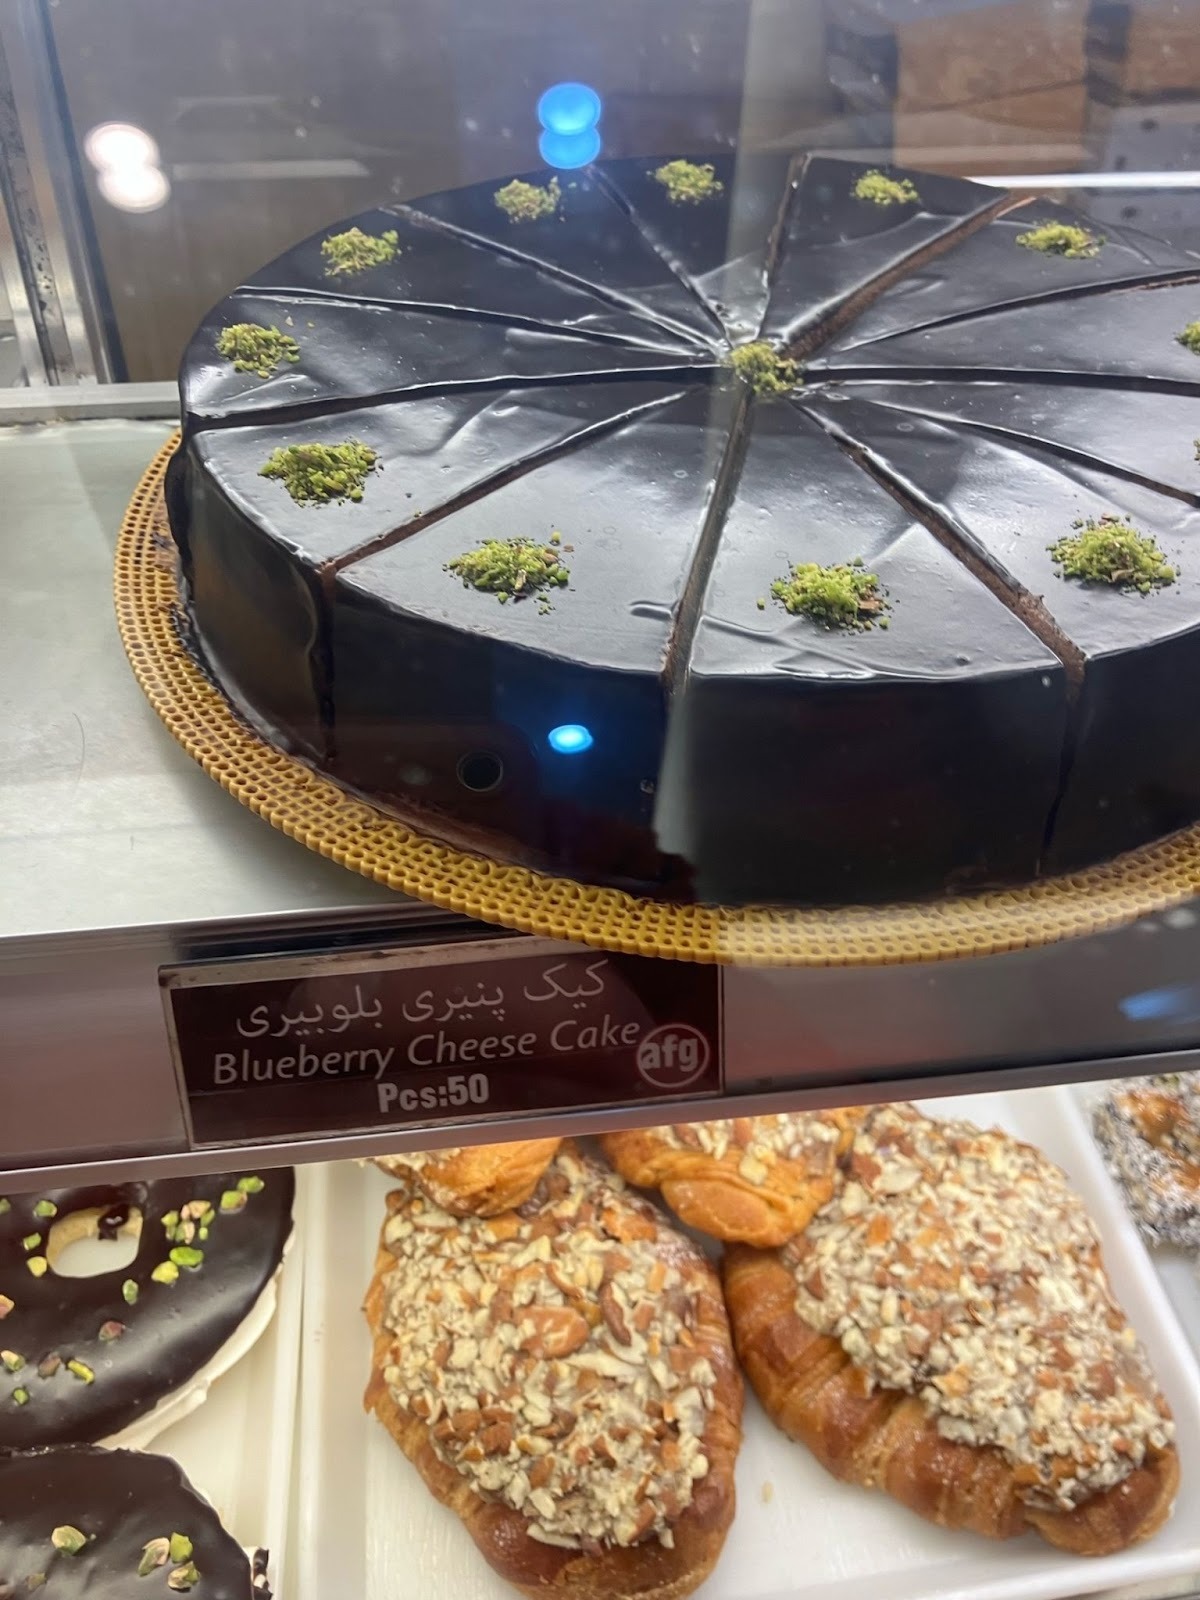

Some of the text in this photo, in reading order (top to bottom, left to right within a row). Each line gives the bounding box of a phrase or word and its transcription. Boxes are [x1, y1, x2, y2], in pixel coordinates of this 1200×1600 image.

[235, 959, 609, 1038] کیک پنیری بلوبیری
[213, 1013, 641, 1085] Blueberry Cheese Cake
[641, 1033, 700, 1073] afg
[377, 1073, 490, 1114] Pcs:50
